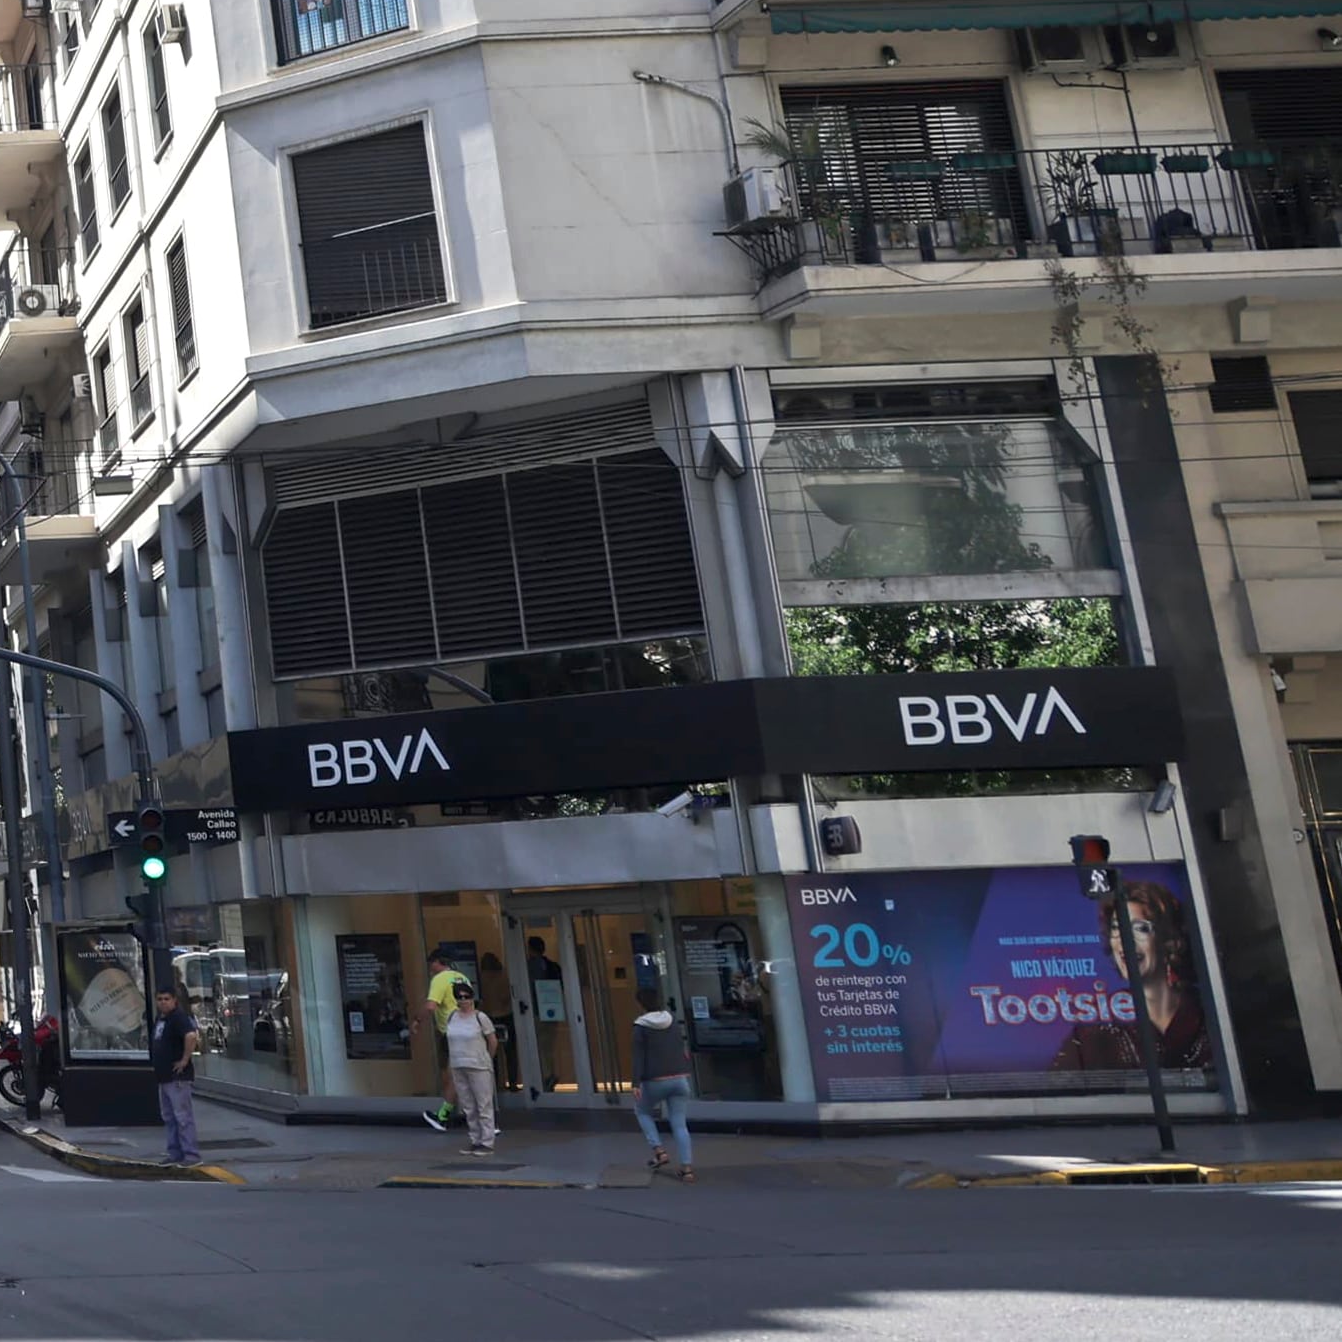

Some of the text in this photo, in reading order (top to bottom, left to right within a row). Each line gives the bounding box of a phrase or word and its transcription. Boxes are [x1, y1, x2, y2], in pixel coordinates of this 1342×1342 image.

[898, 685, 1087, 746] BBVA
[308, 727, 451, 788] BBVA
[198, 810, 235, 819] Avenida
[207, 820, 236, 829] Callao
[187, 832, 208, 841] 1500
[216, 831, 237, 840] 1400
[800, 886, 858, 906] BBVA
[810, 922, 912, 968] 20%
[1011, 956, 1097, 979] NICO VÁZQUEZ
[815, 975, 907, 988] de reintegro con
[817, 988, 900, 1003] tus Tarjetas de
[970, 980, 1137, 1025] Tootsie
[820, 1003, 898, 1017] Crédito BBVA
[837, 1025, 847, 1037] 3
[851, 1024, 901, 1037] cuotas
[827, 1039, 904, 1054] sin interés
